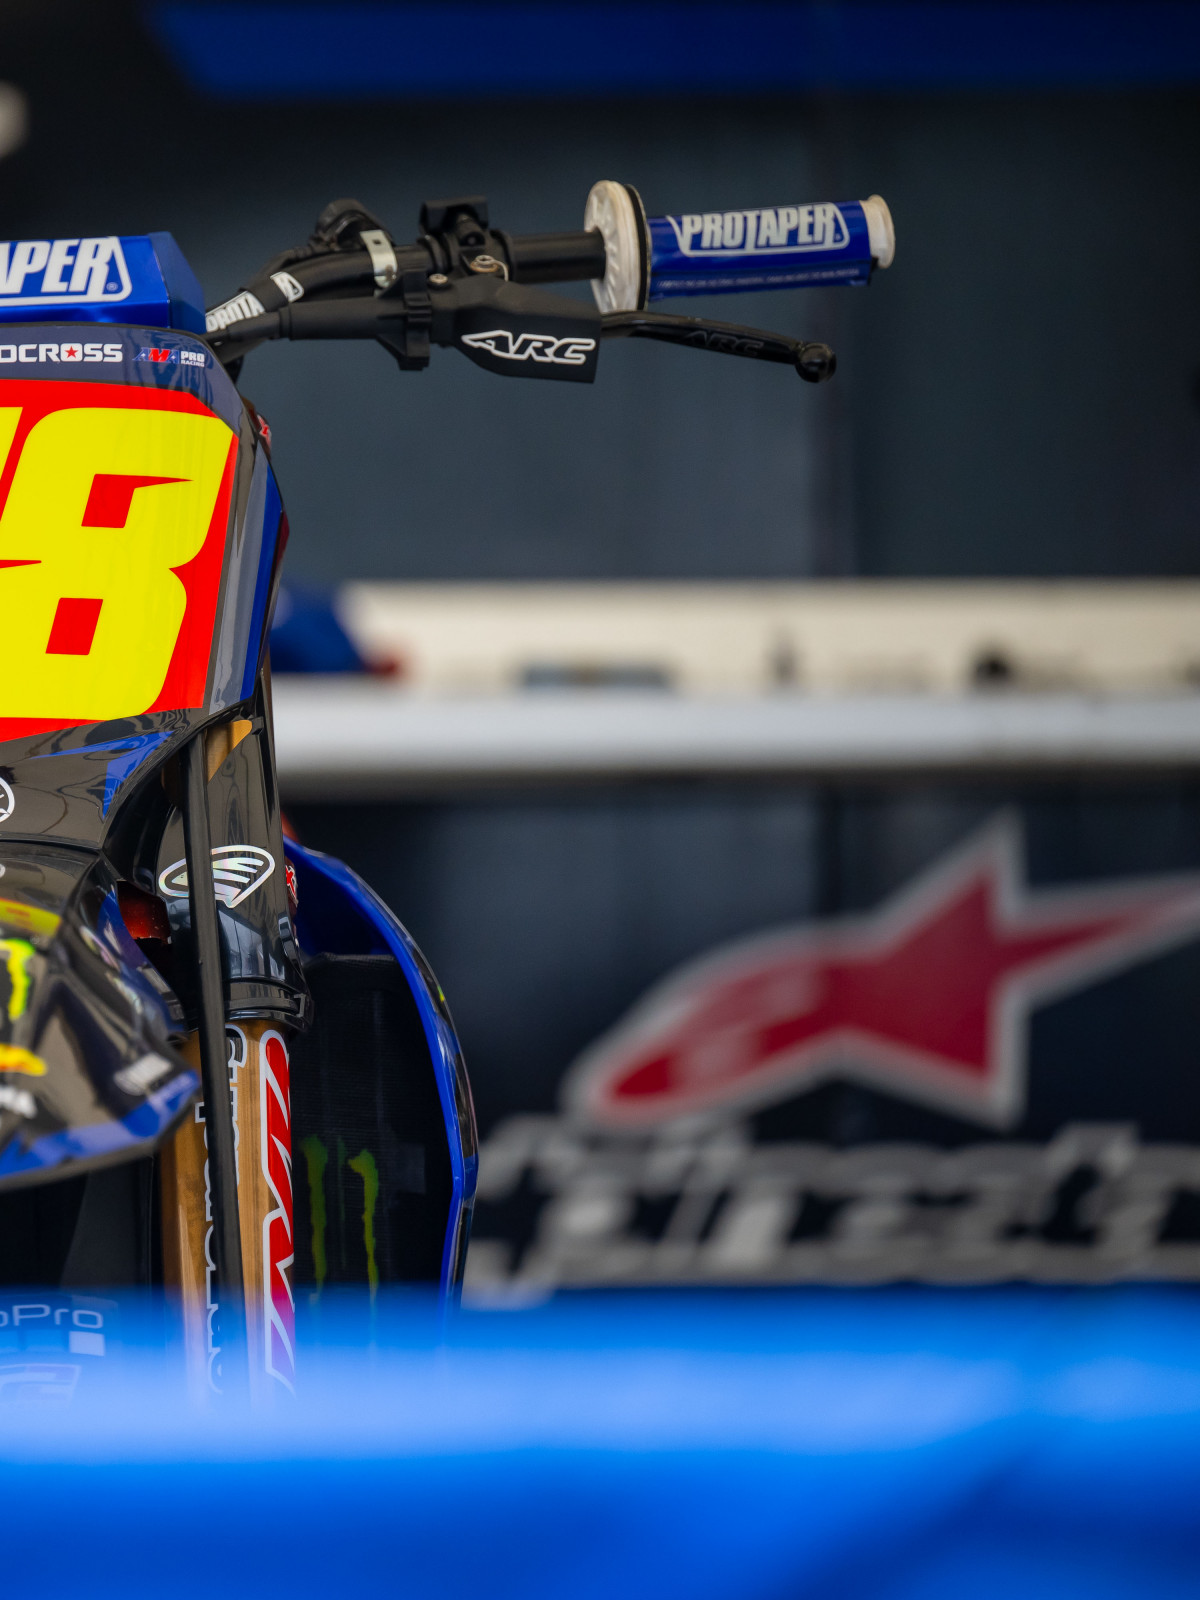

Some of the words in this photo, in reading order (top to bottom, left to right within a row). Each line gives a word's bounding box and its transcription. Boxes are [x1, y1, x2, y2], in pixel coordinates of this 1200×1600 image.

[679, 205, 836, 256] PROTAPER
[132, 347, 179, 364] AMA
[180, 350, 205, 362] PRO
[461, 330, 596, 365] ARC
